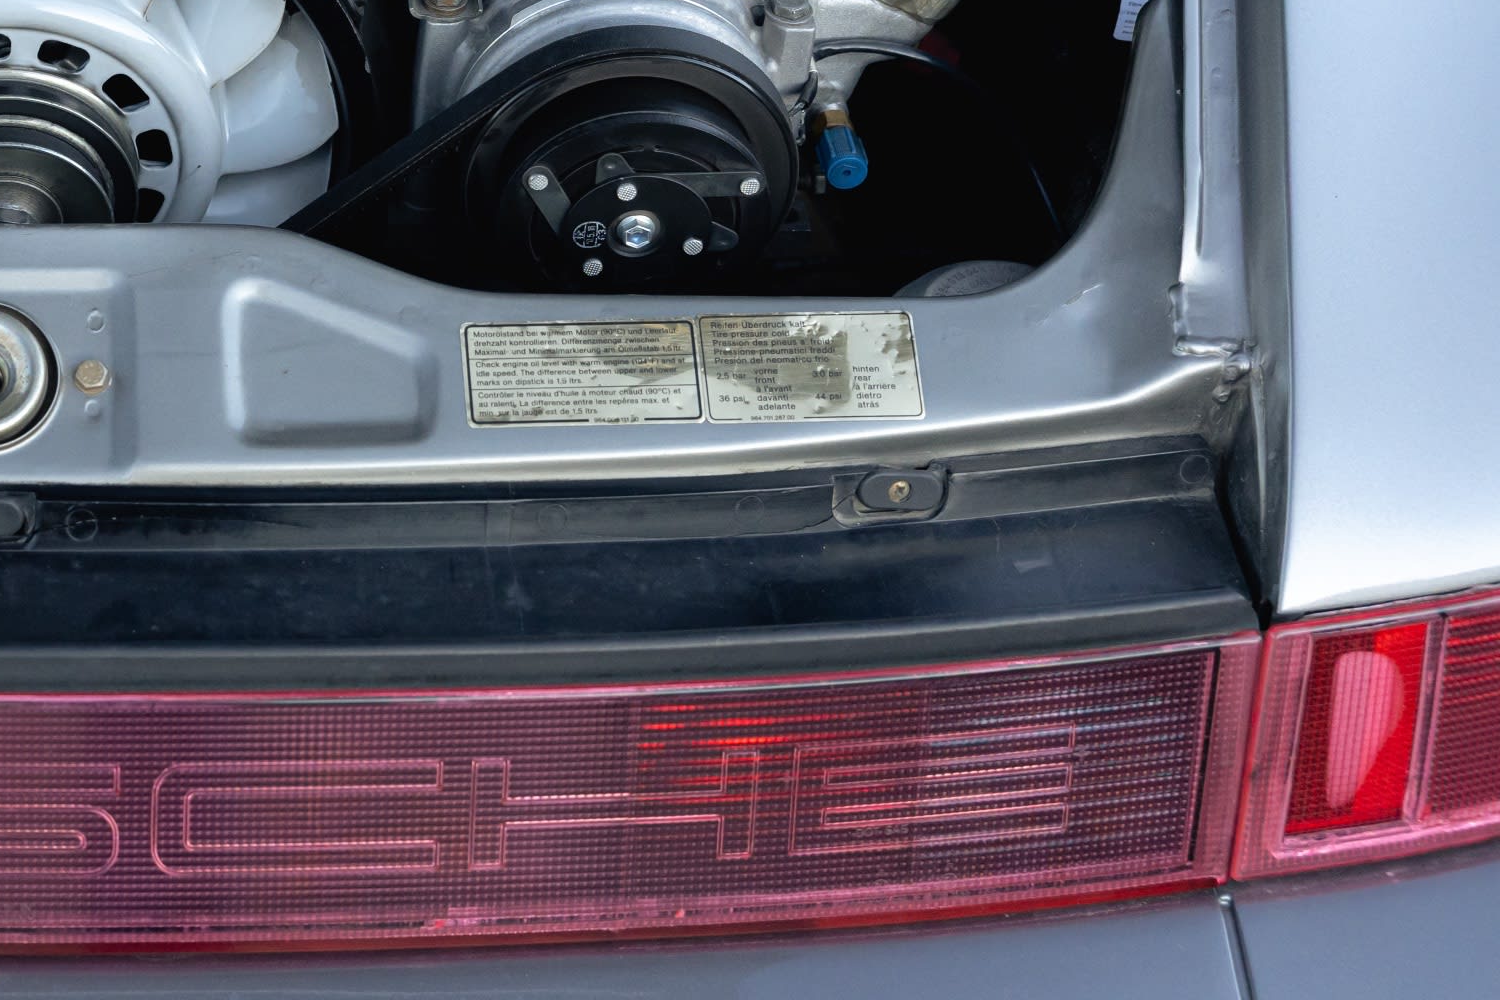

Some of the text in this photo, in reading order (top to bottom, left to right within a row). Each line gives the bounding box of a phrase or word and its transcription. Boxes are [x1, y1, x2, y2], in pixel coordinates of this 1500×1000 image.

[731, 331, 769, 339] pressure
[561, 338, 621, 346] Differenzmenge
[771, 339, 797, 347] pneus
[810, 337, 831, 345] froid
[528, 347, 601, 355] Minimalmarkierung
[759, 347, 807, 356] pneumatici
[502, 361, 528, 369] engine
[603, 359, 630, 367] engine
[493, 371, 518, 379] speed.
[537, 368, 576, 376] difference
[579, 367, 612, 375] between
[615, 368, 637, 376] upper
[733, 371, 746, 379] bar
[515, 378, 545, 386] dipstick
[755, 376, 776, 384] front
[478, 391, 514, 399] Contrôler
[645, 387, 671, 395] (90°C)
[733, 395, 746, 403] psi
[829, 393, 842, 401] psi
[856, 391, 882, 399] dietro
[758, 402, 796, 410] adelante
[522, 408, 543, 417] jauge
